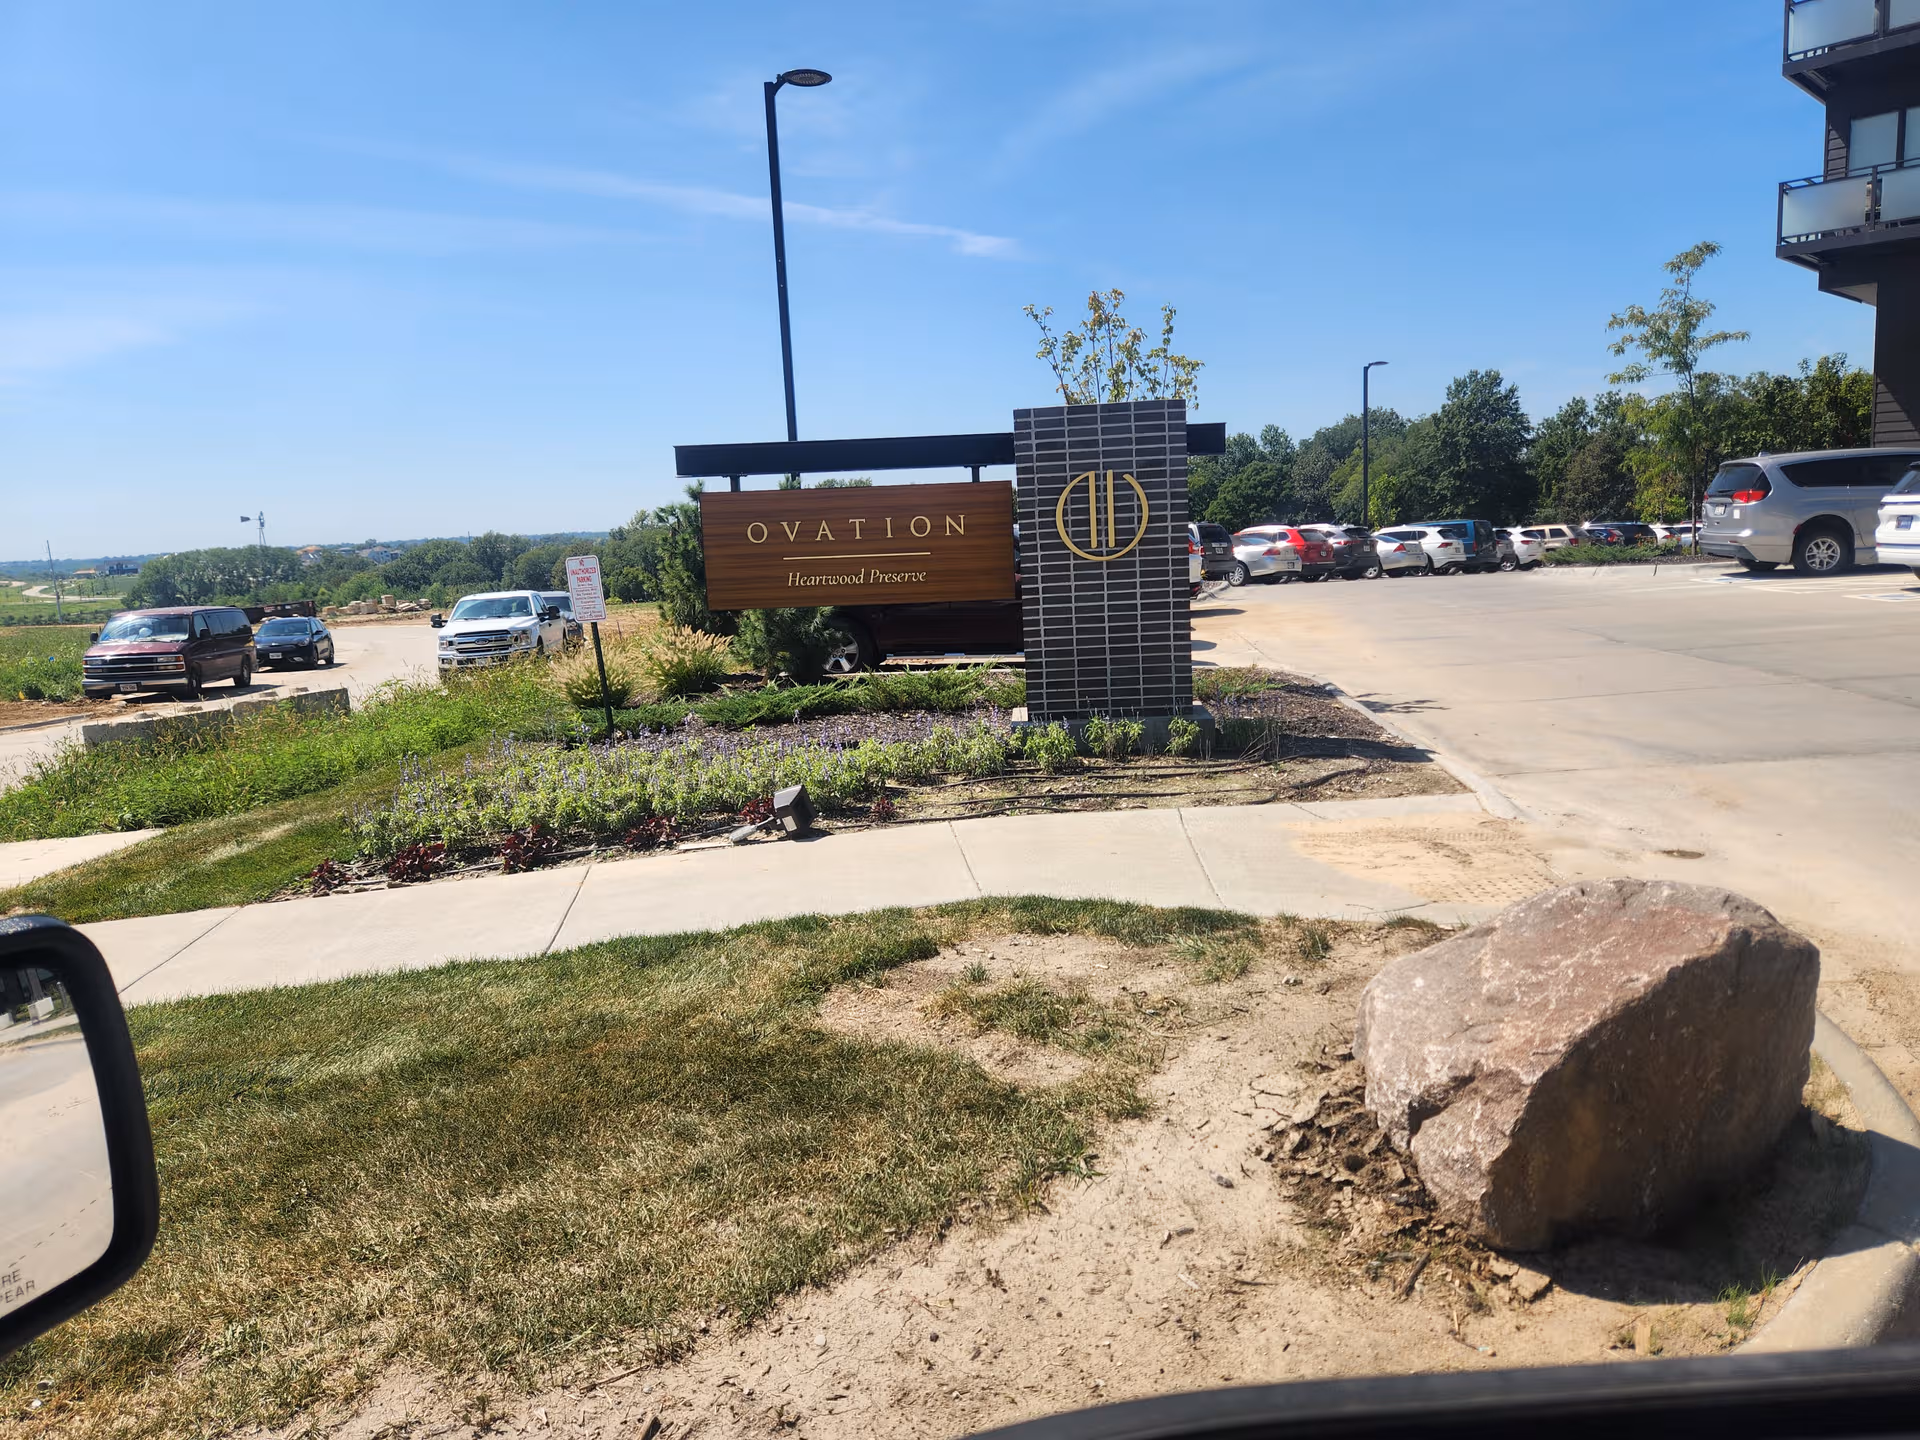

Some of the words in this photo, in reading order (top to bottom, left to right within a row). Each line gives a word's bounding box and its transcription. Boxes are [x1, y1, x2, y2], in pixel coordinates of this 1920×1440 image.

[746, 514, 966, 544] OVATION
[787, 568, 865, 587] Heartwood
[869, 568, 927, 584] Preserve
[0, 1269, 22, 1287] RE
